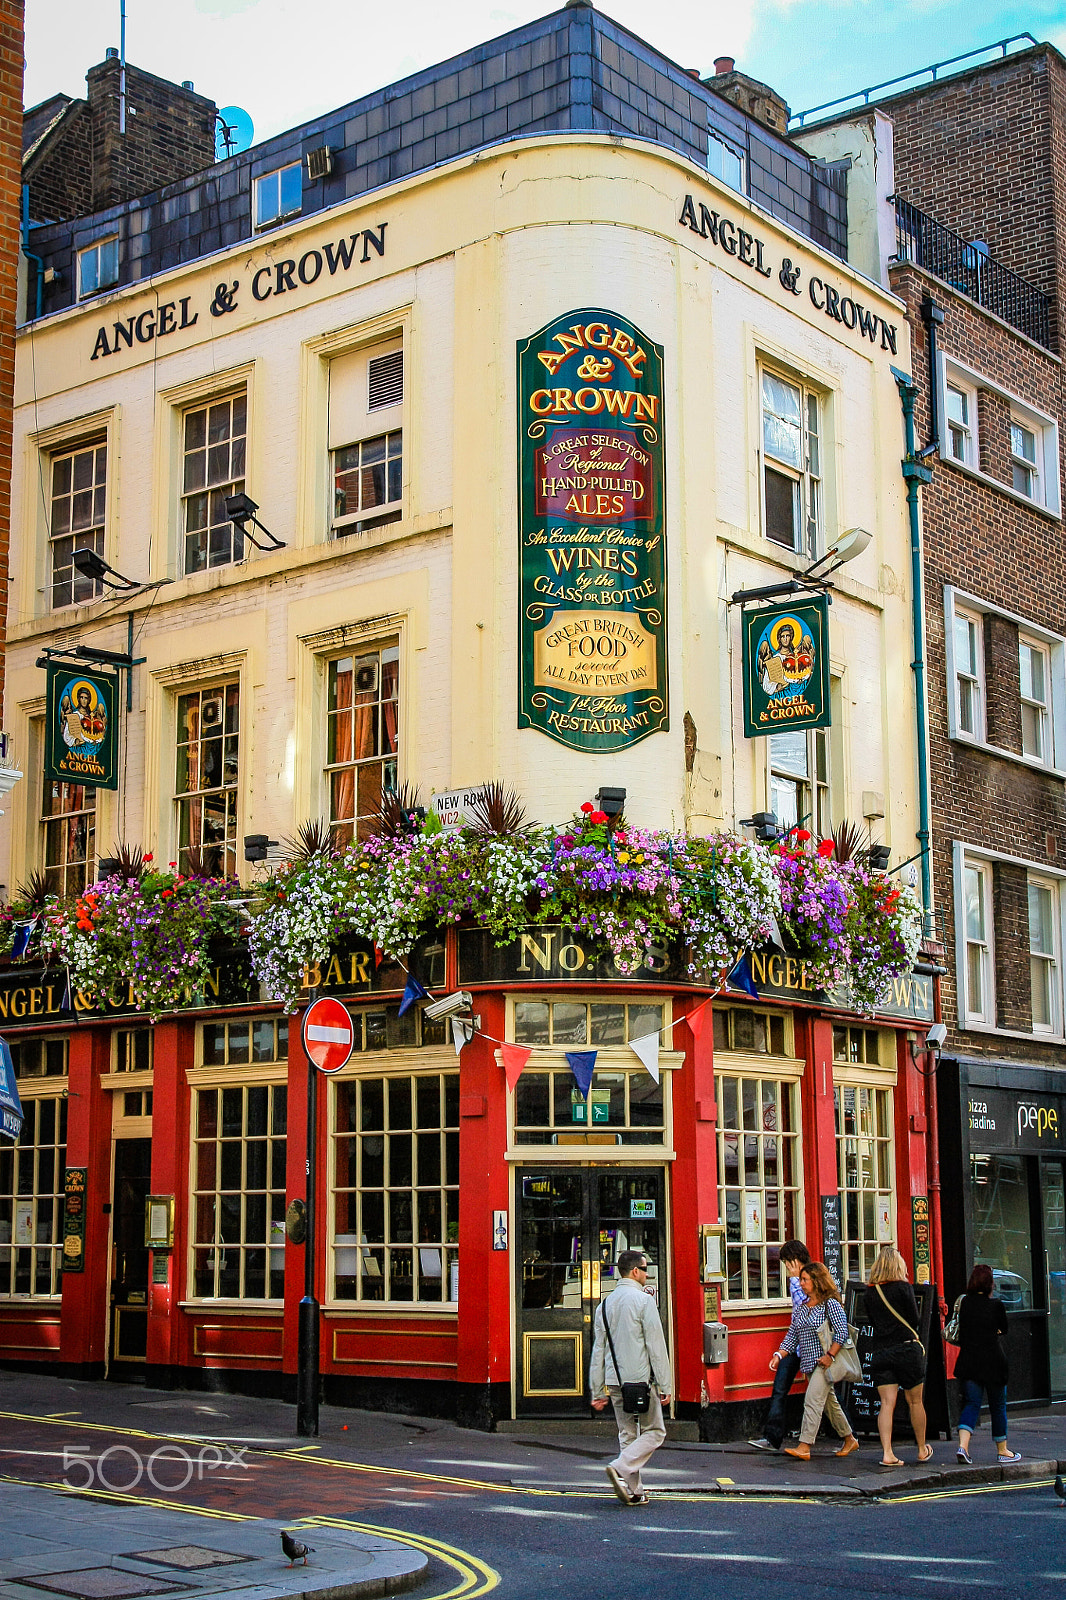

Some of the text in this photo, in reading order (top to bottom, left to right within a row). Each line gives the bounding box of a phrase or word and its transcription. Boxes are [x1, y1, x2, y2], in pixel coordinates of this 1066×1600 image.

[678, 193, 898, 357] ANGEL & CROWN
[89, 222, 389, 361] ANGEL & CROWN
[537, 322, 649, 377] ANGEL
[577, 355, 613, 381] &
[529, 387, 659, 422] CROWN
[542, 434, 649, 467] A GREAT SELECTION
[589, 446, 602, 460] of
[559, 453, 630, 474] Regional
[541, 475, 645, 500] HAND-PULLED
[564, 494, 625, 517] ALES
[524, 527, 660, 553] An Excellent Choice of
[545, 547, 639, 578] WINES
[533, 574, 657, 606] GLASS OR BOTTLE
[575, 572, 615, 589] by the
[545, 618, 645, 649] GREAT BRITISH
[568, 635, 627, 658] FOOD
[543, 665, 649, 687] ALL DAY EVERY DAY
[574, 659, 620, 671] served
[567, 695, 629, 718] 1st Floor
[759, 703, 816, 722] & CROWN
[766, 694, 808, 711] ANGEL
[547, 710, 651, 736] RESTAURANT
[59, 760, 105, 776] & CROWN
[65, 751, 100, 766] ANGEL
[437, 795, 459, 811] NEW
[438, 811, 459, 826] WC2
[516, 933, 594, 971] No.
[300, 951, 371, 990] BAR
